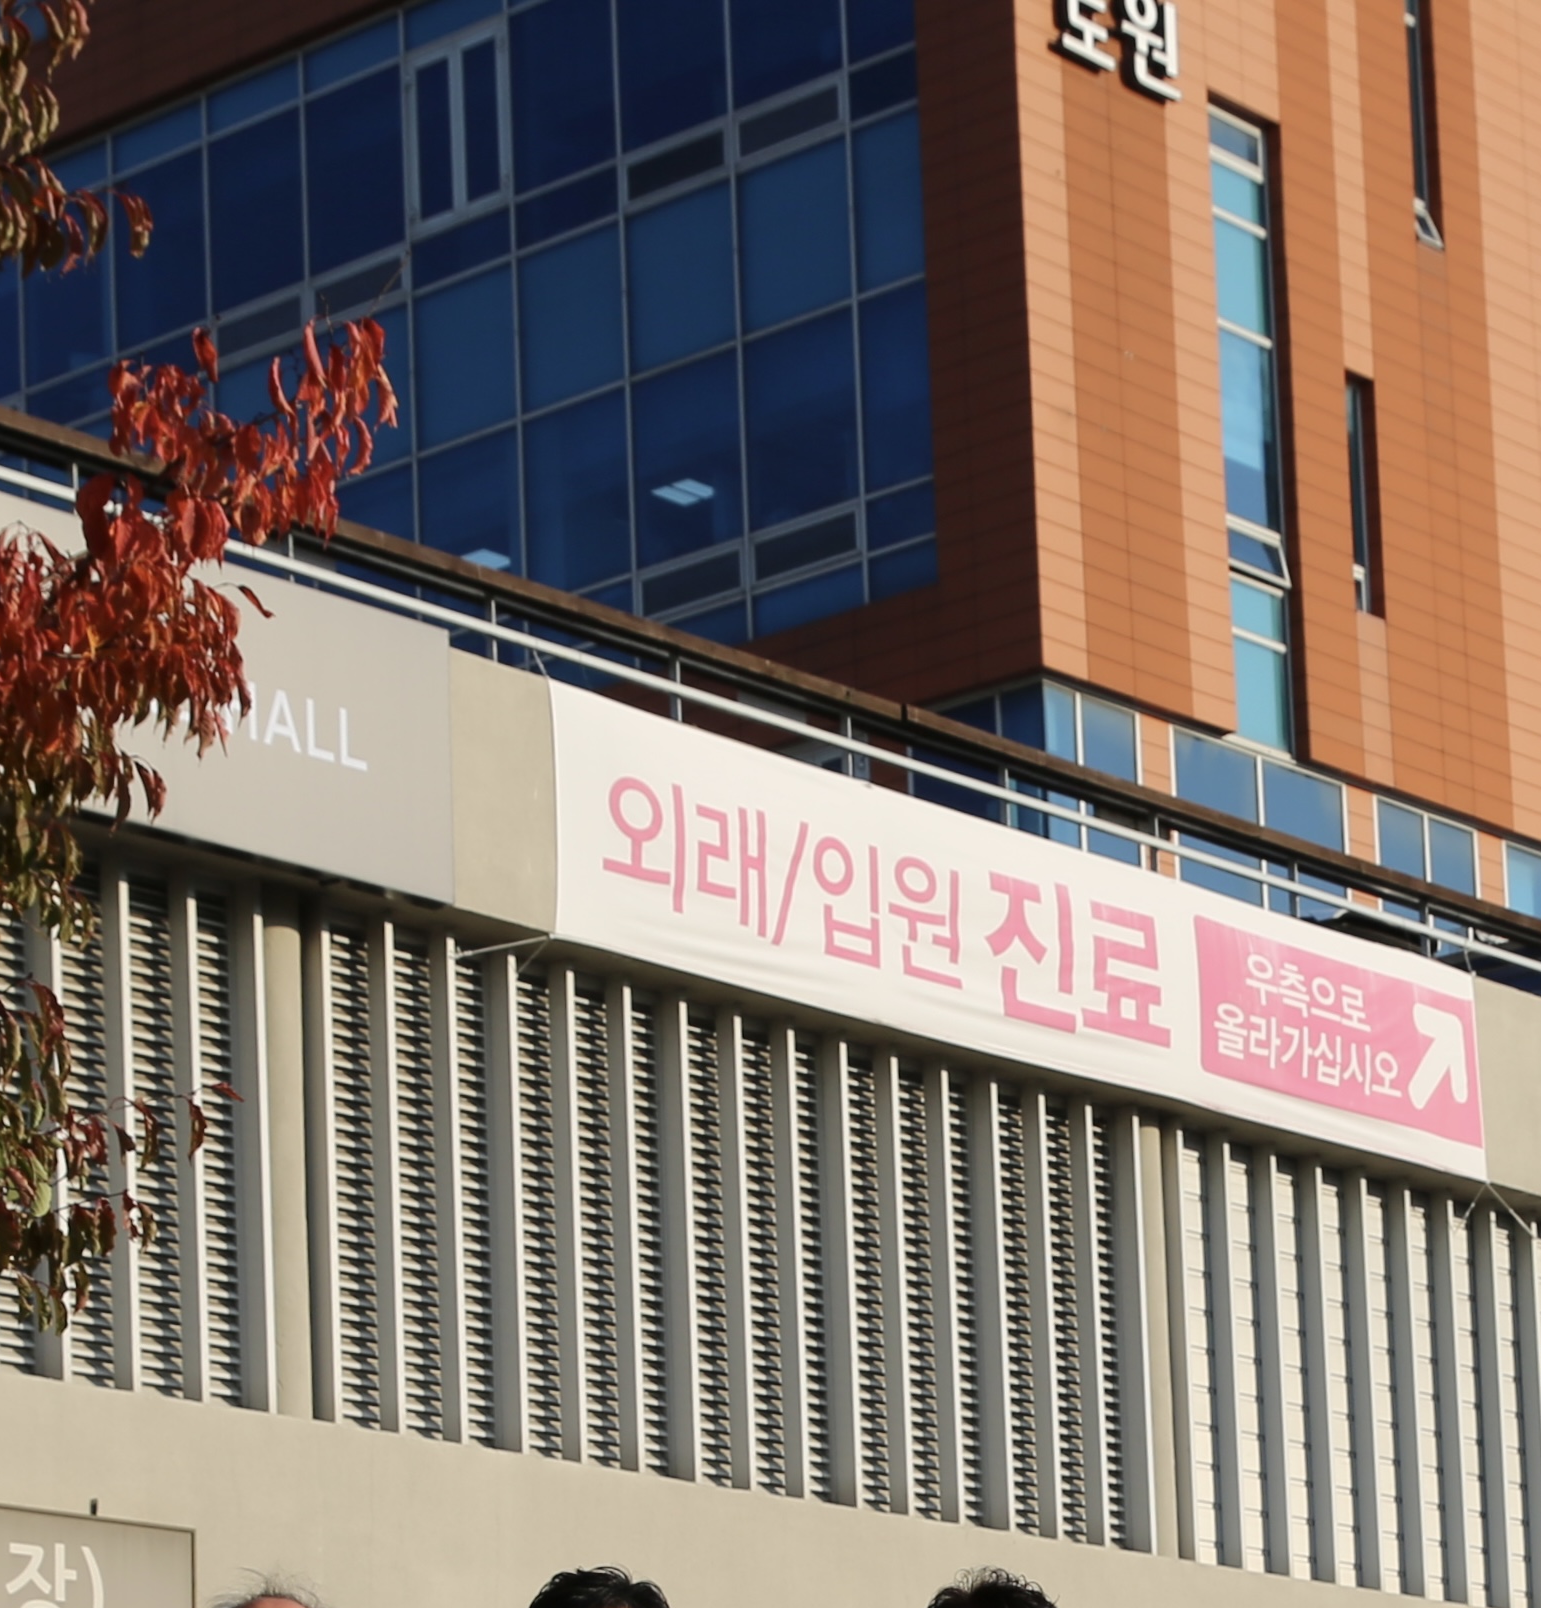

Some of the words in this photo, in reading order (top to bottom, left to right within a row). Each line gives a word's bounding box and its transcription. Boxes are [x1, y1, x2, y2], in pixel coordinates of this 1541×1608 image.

[602, 776, 964, 989] 외래/입원
[986, 870, 1172, 1050] 진료
[1245, 953, 1372, 1034] 우측으로
[1214, 1003, 1403, 1099] 올라가십시오
